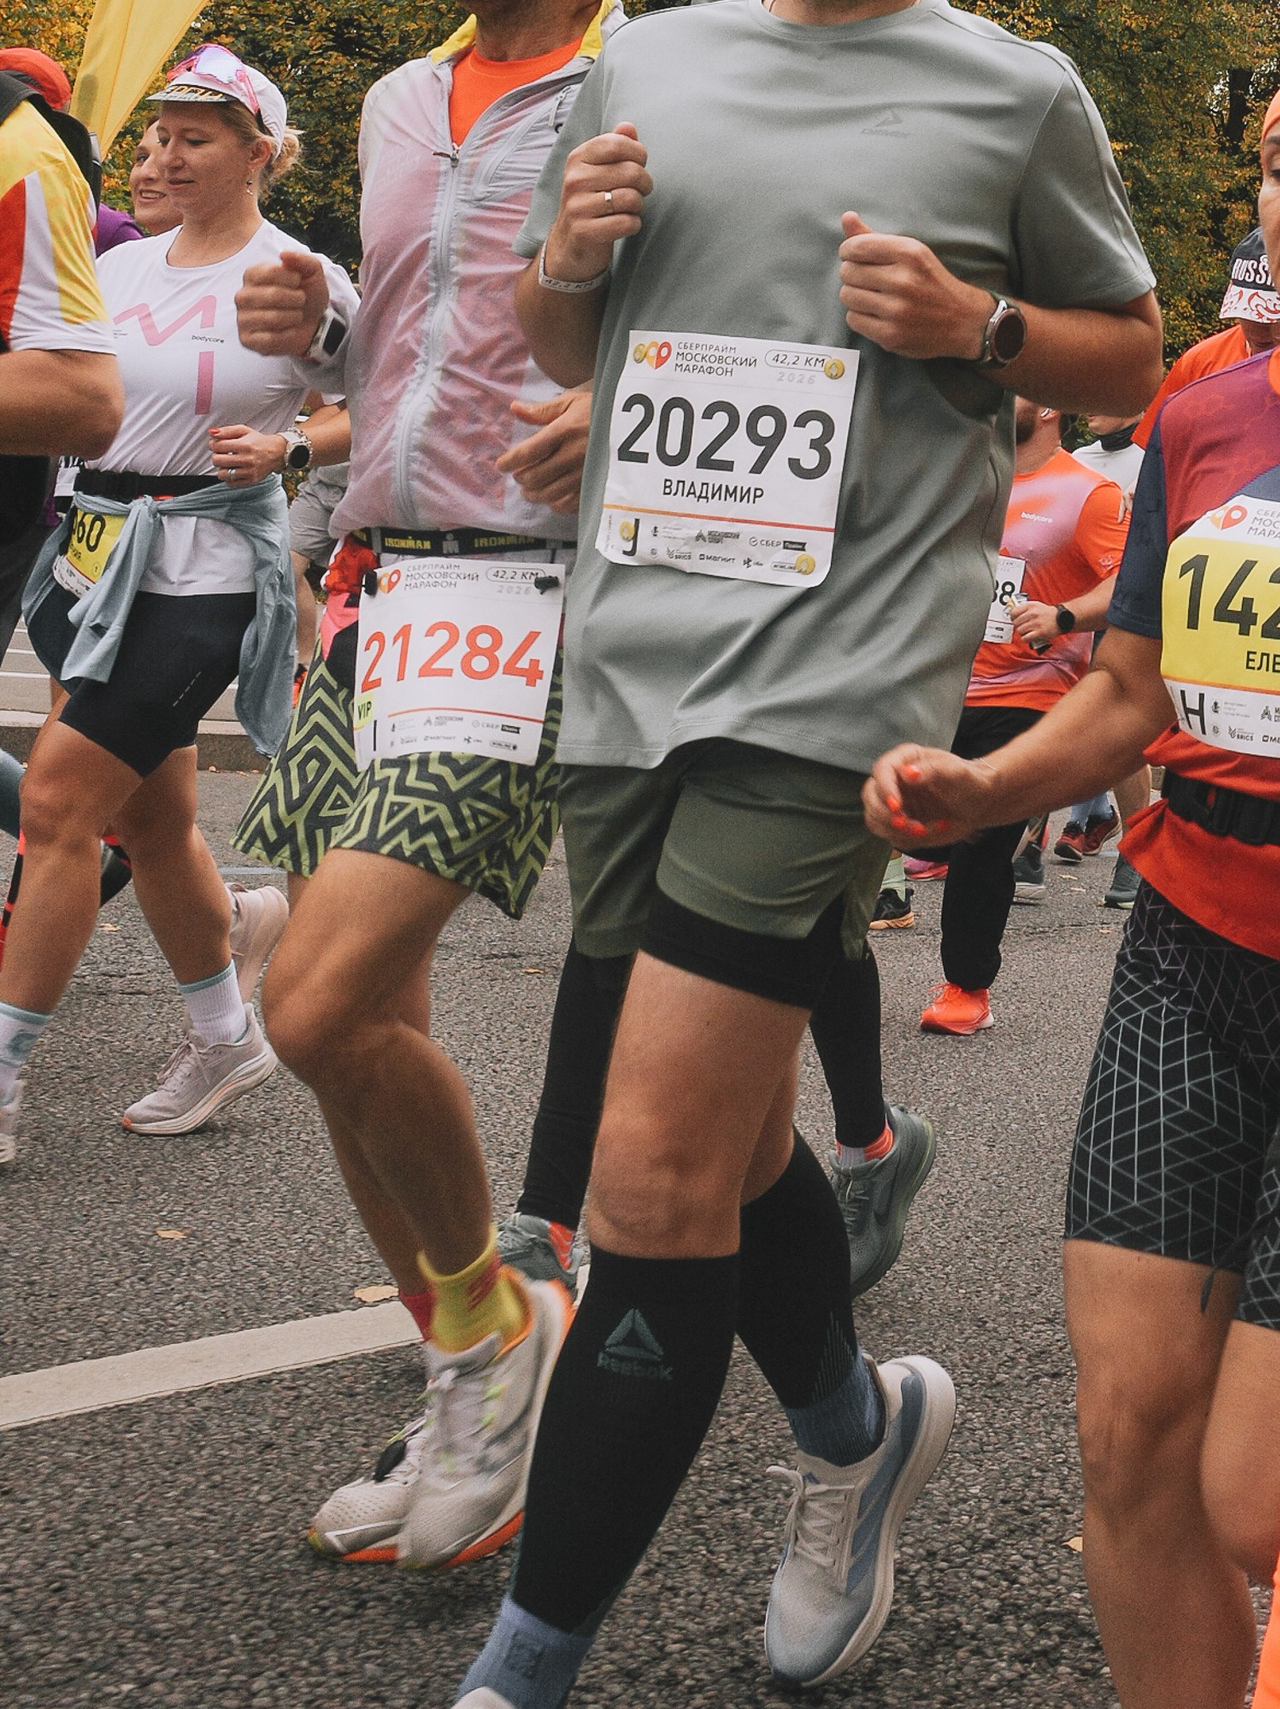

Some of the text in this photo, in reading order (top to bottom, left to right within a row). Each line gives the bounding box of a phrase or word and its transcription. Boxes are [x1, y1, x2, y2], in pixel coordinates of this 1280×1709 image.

[677, 341, 737, 354] СБЕРПРАЙМ
[675, 352, 757, 368] МОСКОВСКИЙ
[772, 353, 826, 368] 42,2 КМ
[674, 363, 734, 377] МАРАФОН
[617, 392, 836, 480] 20293
[662, 477, 764, 504] ВЛАДИМИР
[385, 536, 432, 550] IRONMAN
[622, 518, 640, 557] J
[407, 562, 461, 573] СБЕРПРАЙМ
[405, 571, 479, 582] МОСКОВСКИЙ
[403, 580, 457, 591] МАРАФОН
[361, 621, 544, 693] 21284
[358, 700, 372, 720] VIP
[1180, 690, 1207, 736] H
